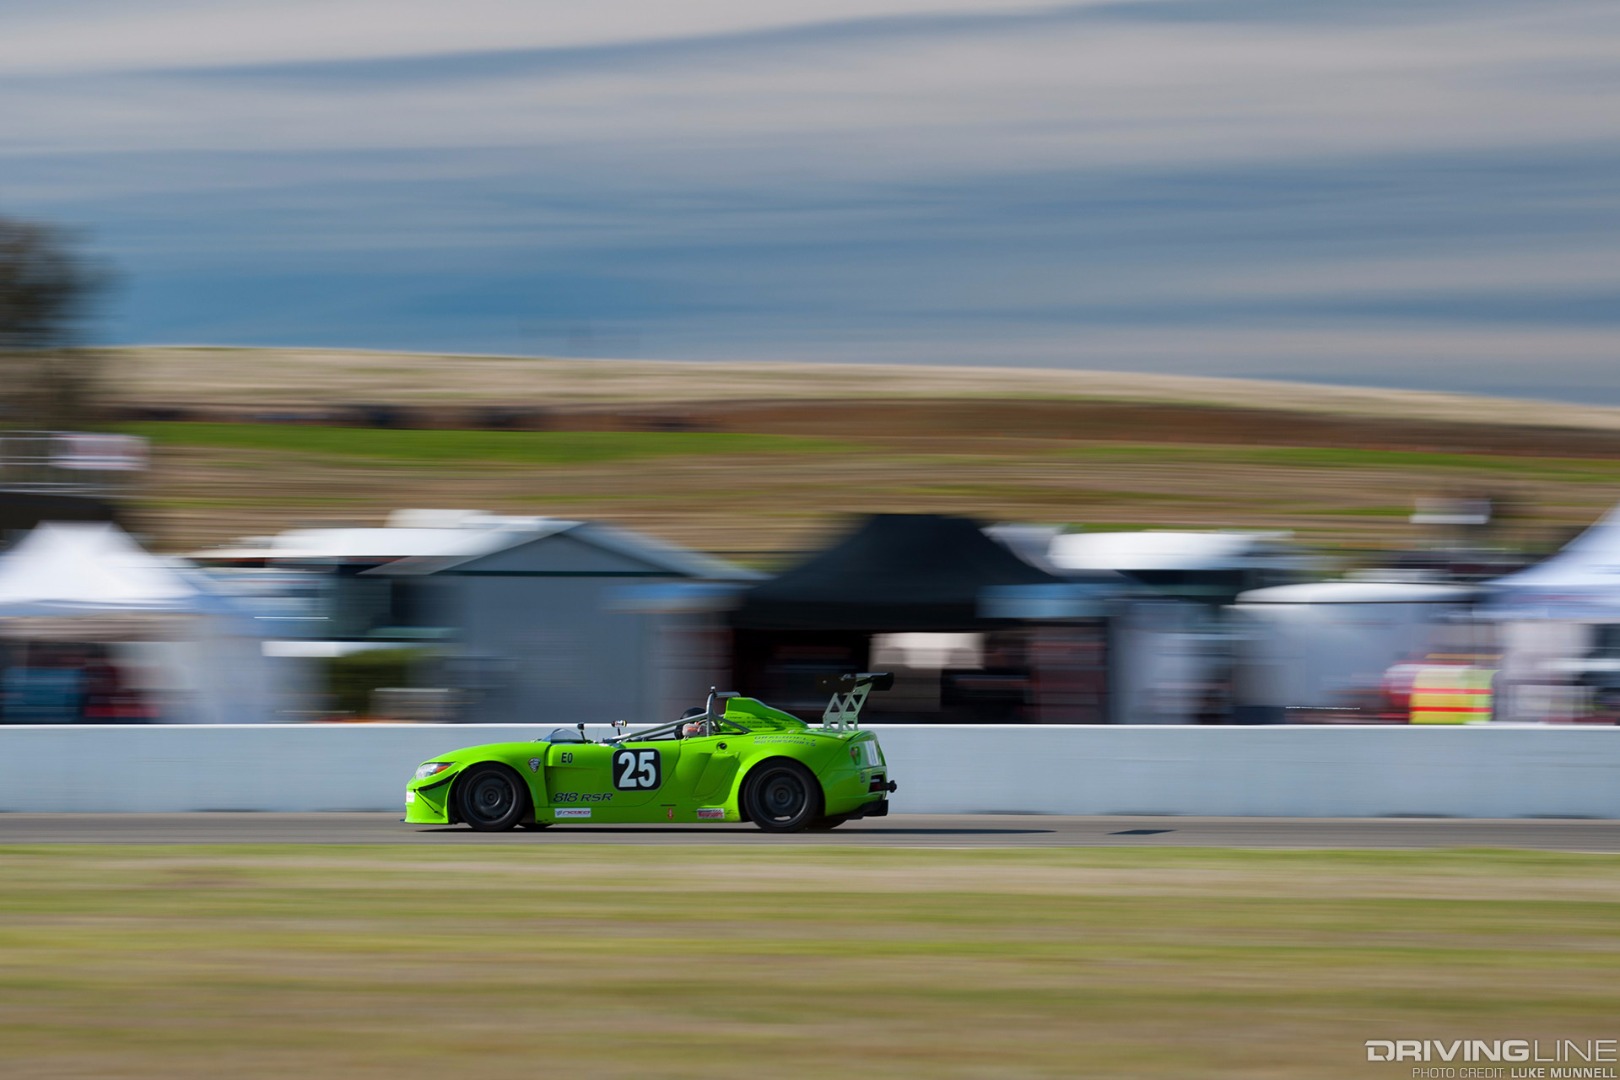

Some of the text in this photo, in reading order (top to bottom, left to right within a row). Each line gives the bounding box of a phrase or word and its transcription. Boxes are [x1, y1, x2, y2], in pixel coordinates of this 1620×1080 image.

[618, 752, 656, 788] 25
[554, 792, 613, 802] 818 RSR
